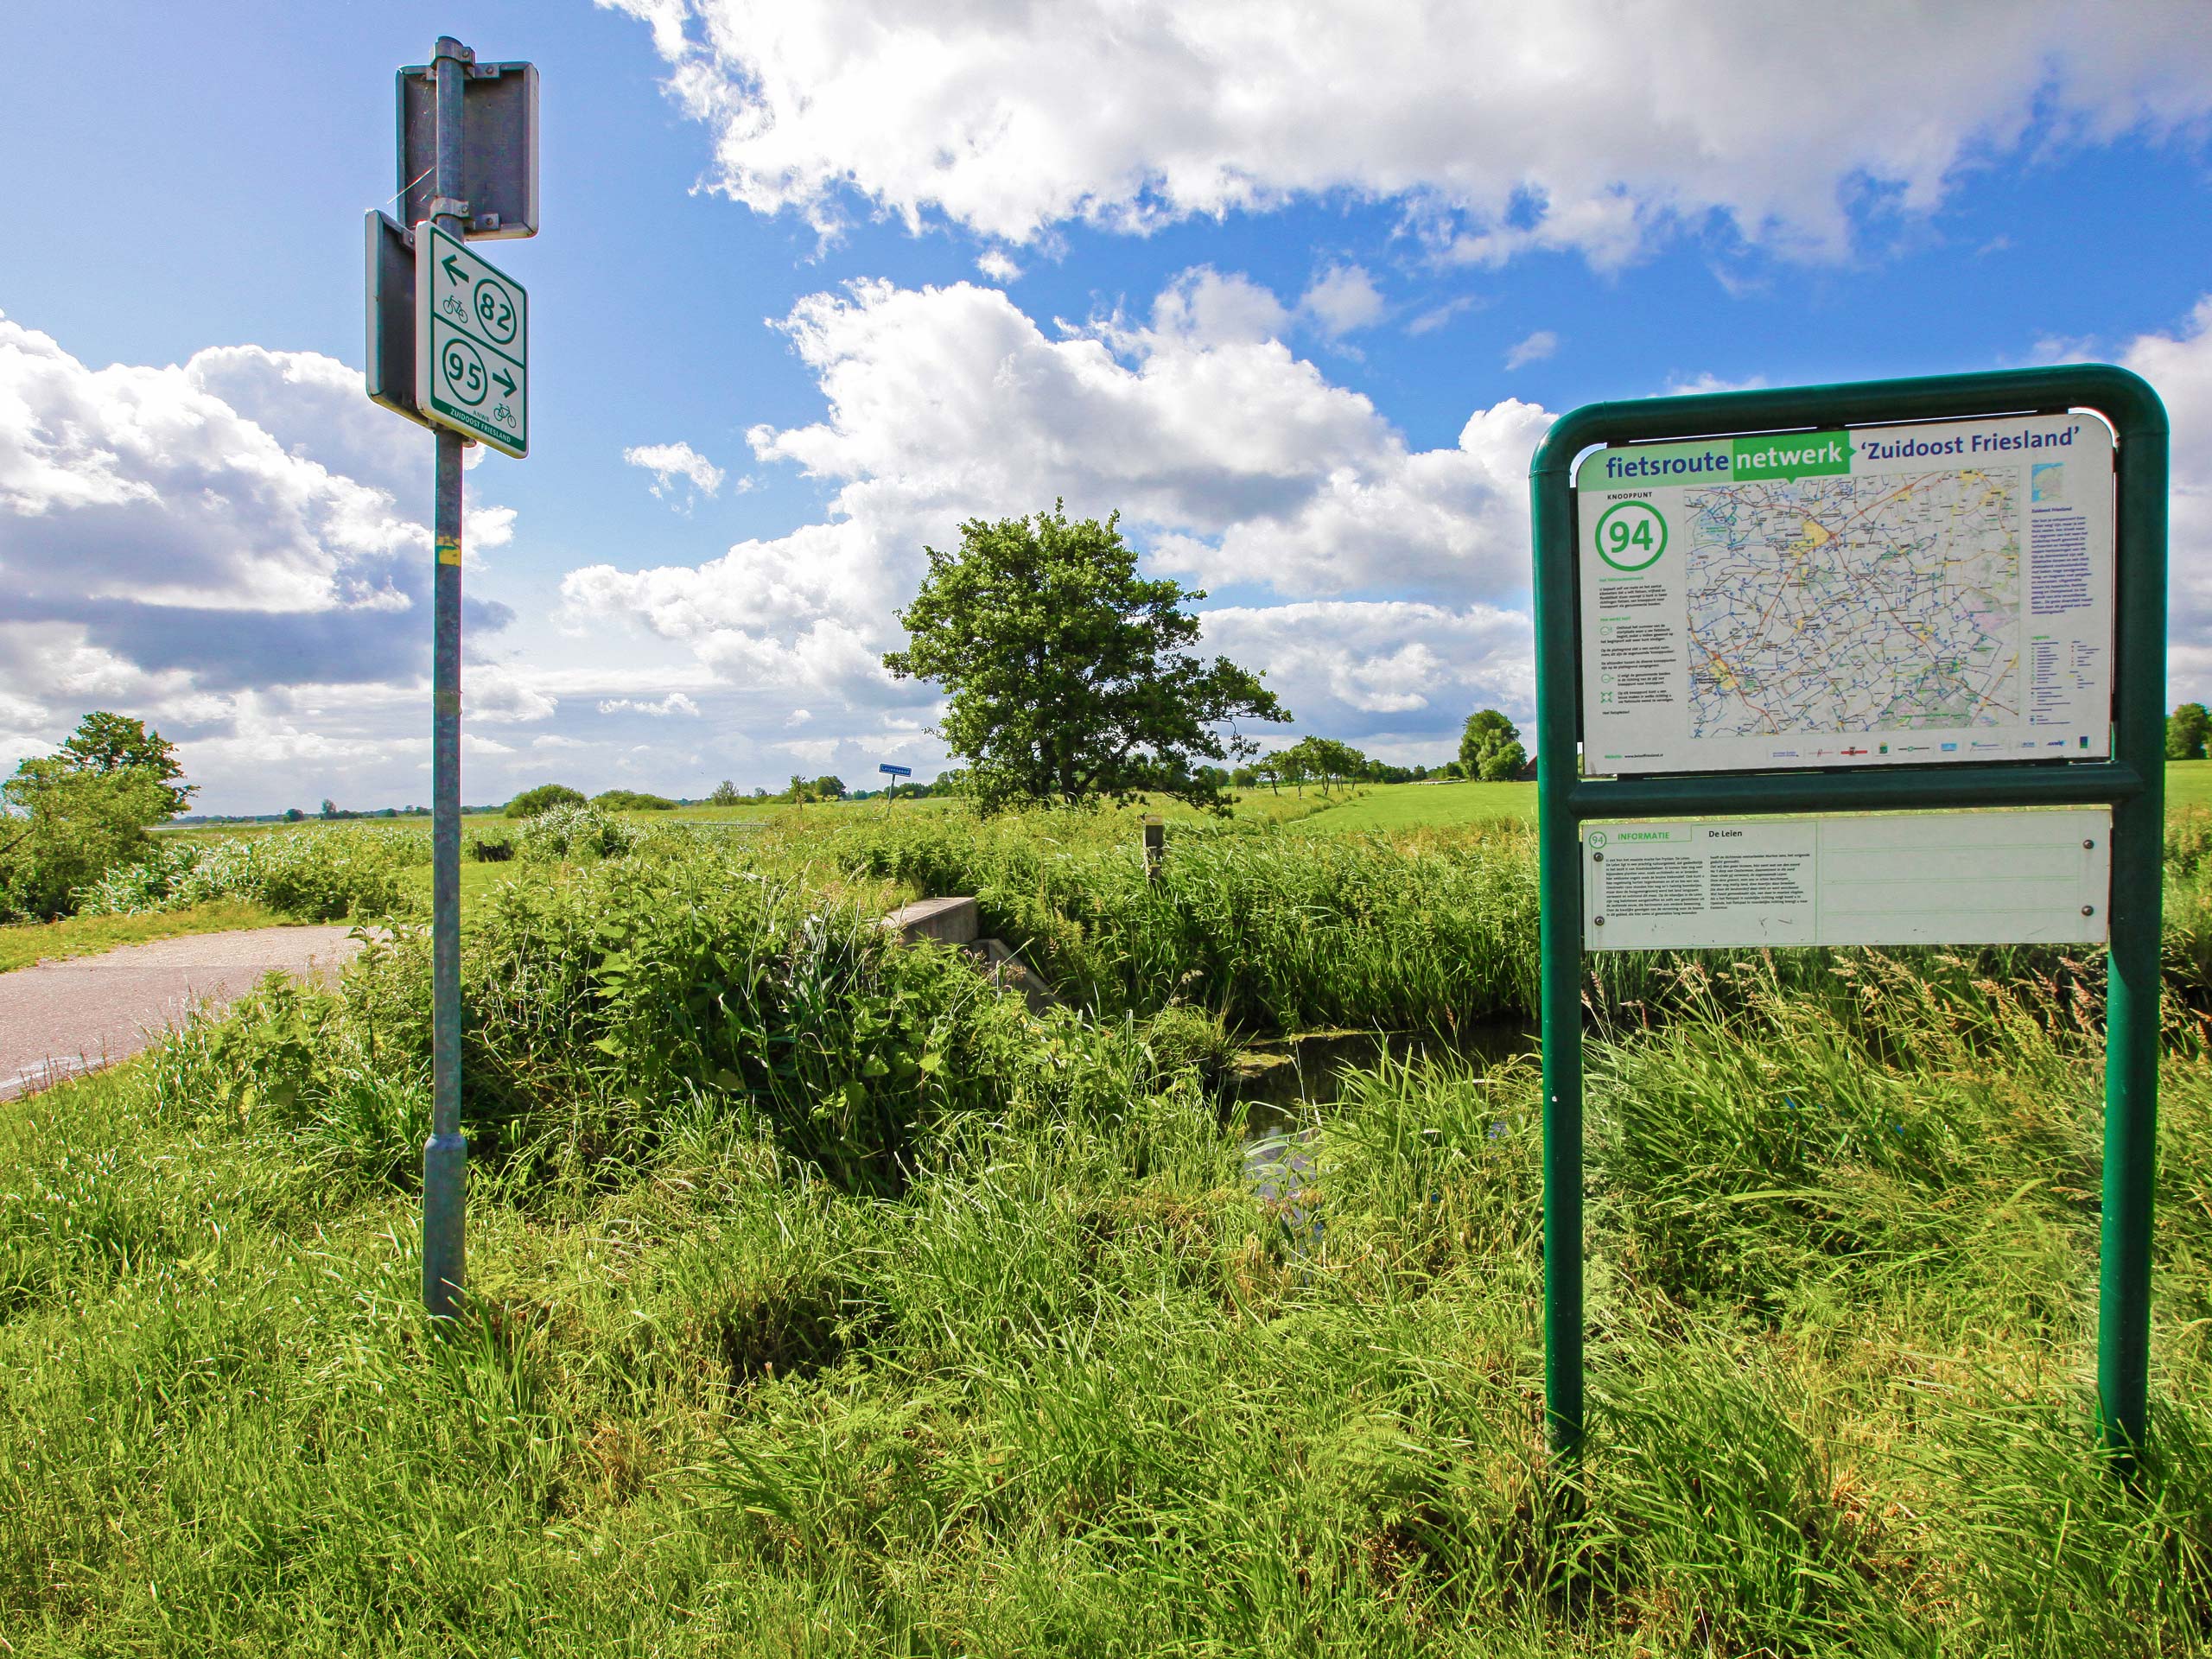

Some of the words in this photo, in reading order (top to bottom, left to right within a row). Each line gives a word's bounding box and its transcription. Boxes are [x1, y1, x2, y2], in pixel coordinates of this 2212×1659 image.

[480, 292, 511, 332] 82
[448, 353, 481, 391] 95
[450, 408, 480, 428] ZUIDOOST
[480, 423, 512, 443] FRIESLAND
[473, 410, 490, 423] ANWB
[1606, 451, 1729, 478] fietsroute
[1736, 441, 1842, 469] netwerk
[1861, 436, 1964, 460] ‘Zuidoost
[1971, 426, 2080, 452] Friesland’
[1607, 491, 1652, 499] KNOOPPUNT
[1609, 519, 1654, 553] 94
[1592, 836, 1604, 845] 94
[1618, 831, 1670, 840] INFORMATIE
